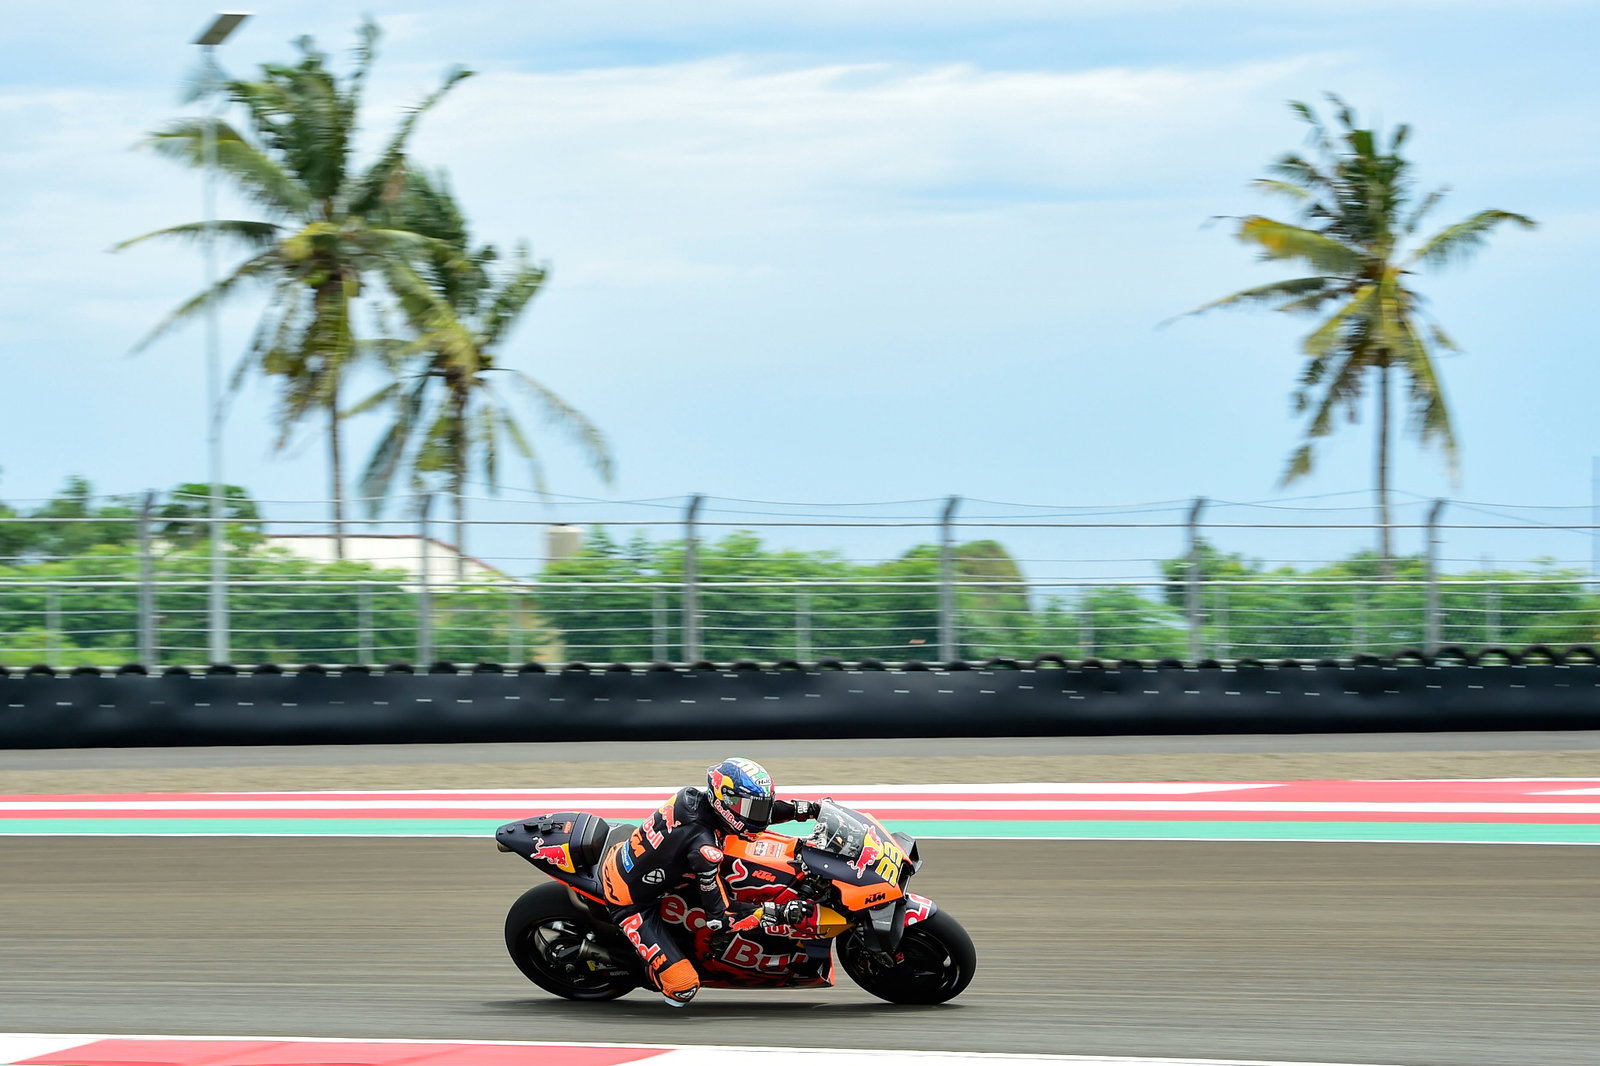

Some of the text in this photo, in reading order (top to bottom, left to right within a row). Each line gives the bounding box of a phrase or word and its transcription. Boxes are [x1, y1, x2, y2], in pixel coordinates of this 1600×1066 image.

[642, 811, 664, 850] Bull
[752, 869, 777, 883] KTM
[874, 841, 903, 888] 33
[864, 892, 886, 905] KTM
[619, 912, 661, 963] Red
